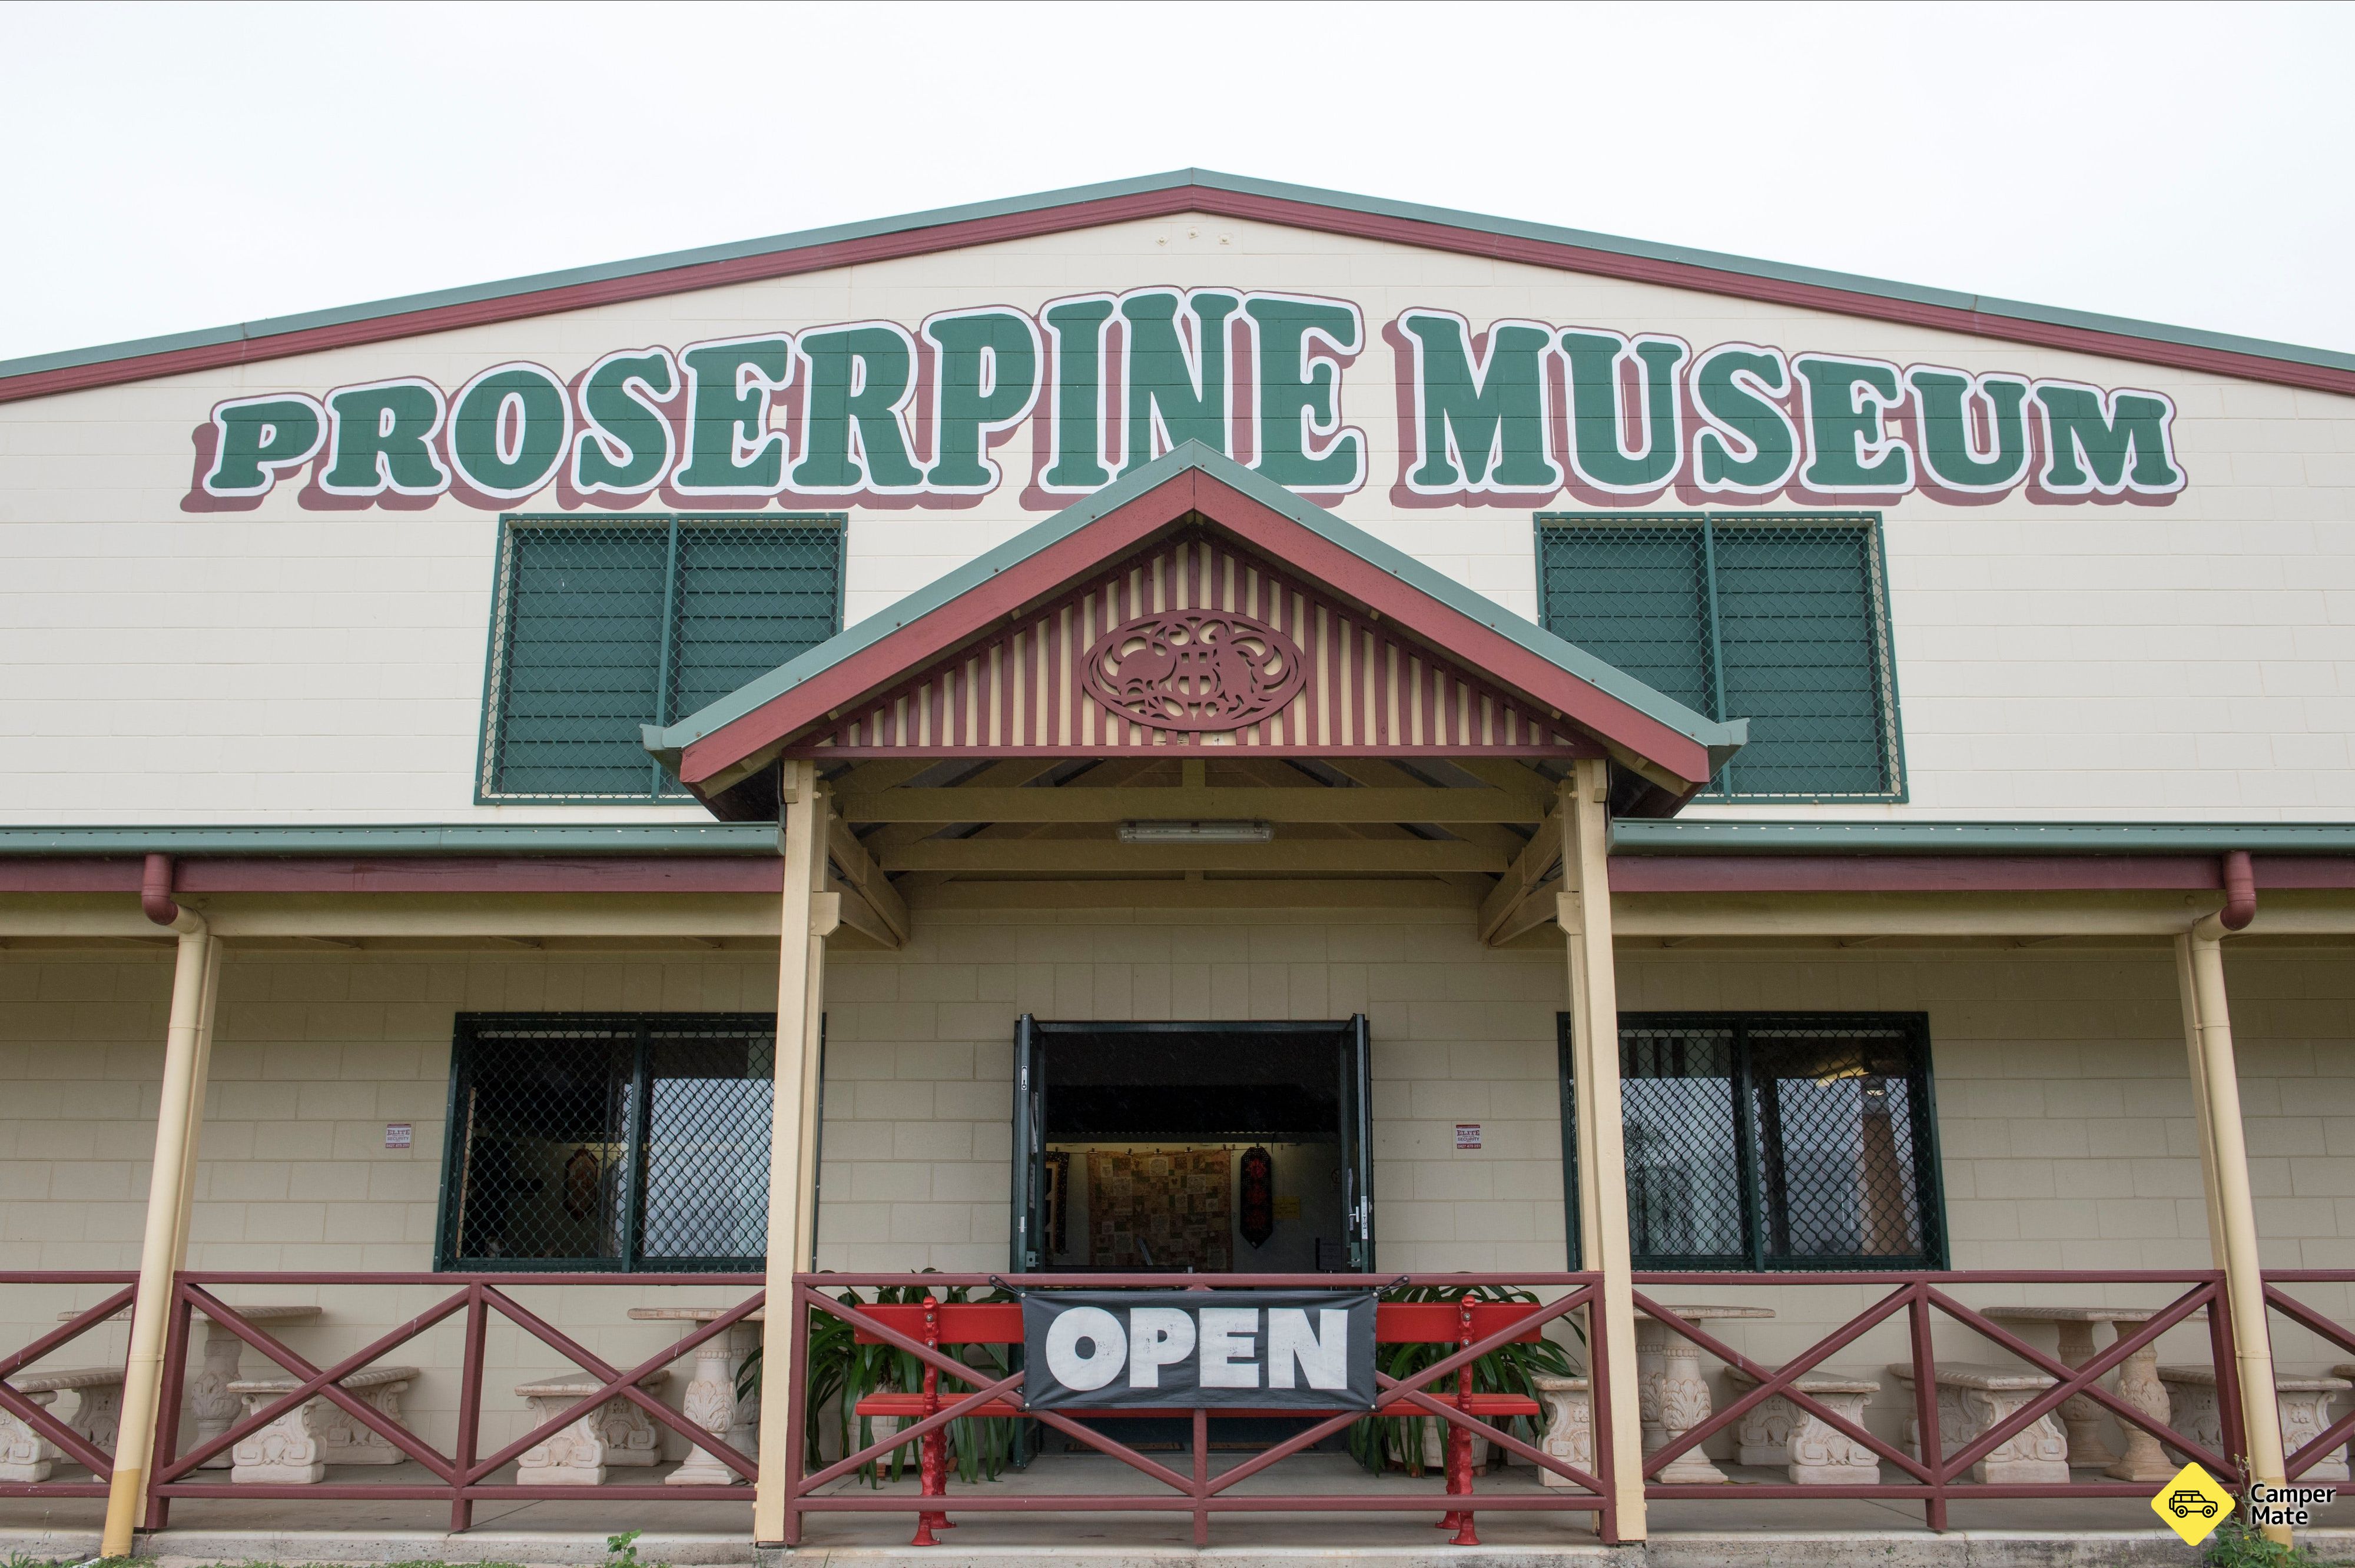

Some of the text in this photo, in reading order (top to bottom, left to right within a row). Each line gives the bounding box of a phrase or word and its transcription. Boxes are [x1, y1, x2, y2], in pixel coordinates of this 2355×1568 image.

[203, 286, 2187, 504] PROSERPINE MUSEUM
[1046, 1306, 1348, 1391] OPEN
